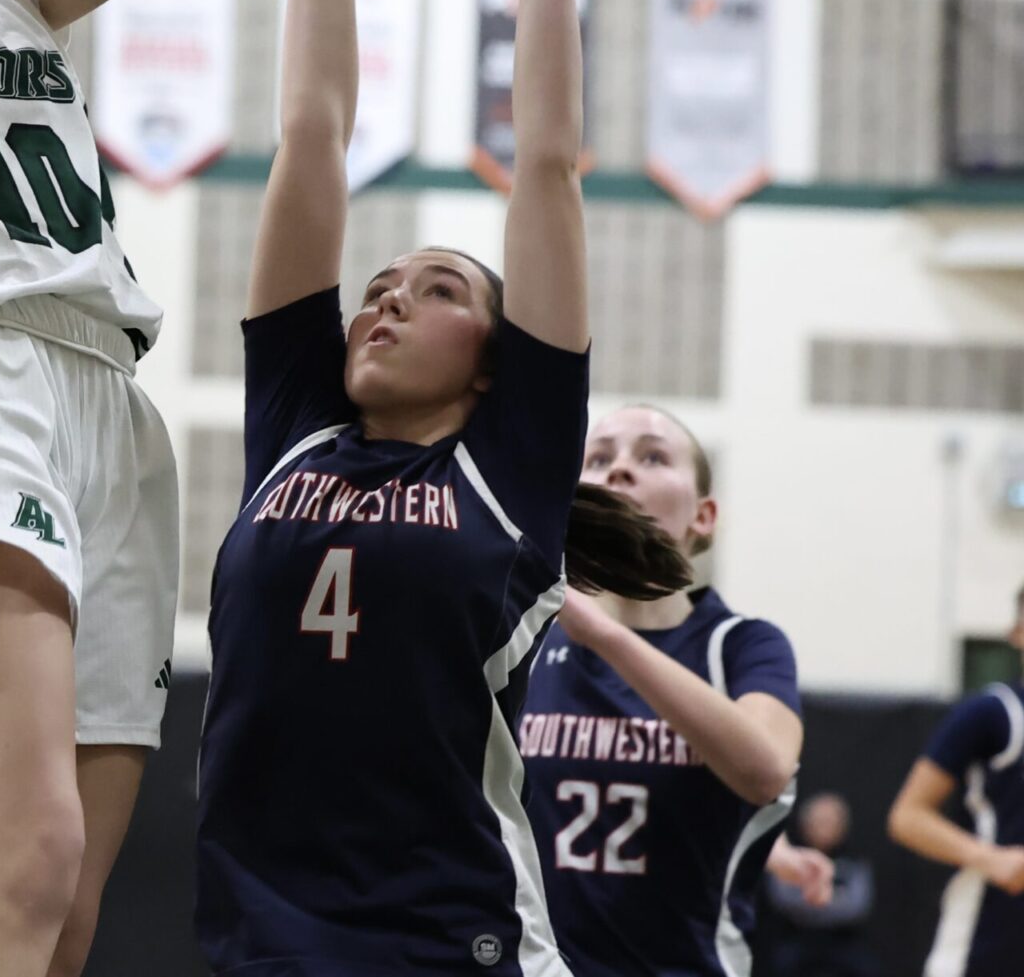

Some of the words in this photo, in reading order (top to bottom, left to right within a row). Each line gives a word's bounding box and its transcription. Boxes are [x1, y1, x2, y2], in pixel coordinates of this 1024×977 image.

[10, 491, 67, 549] AL
[252, 470, 458, 531] OUTHWSTERN
[299, 546, 360, 661] 4
[518, 712, 702, 766] SOUTHWESTER
[553, 779, 650, 875] 22
